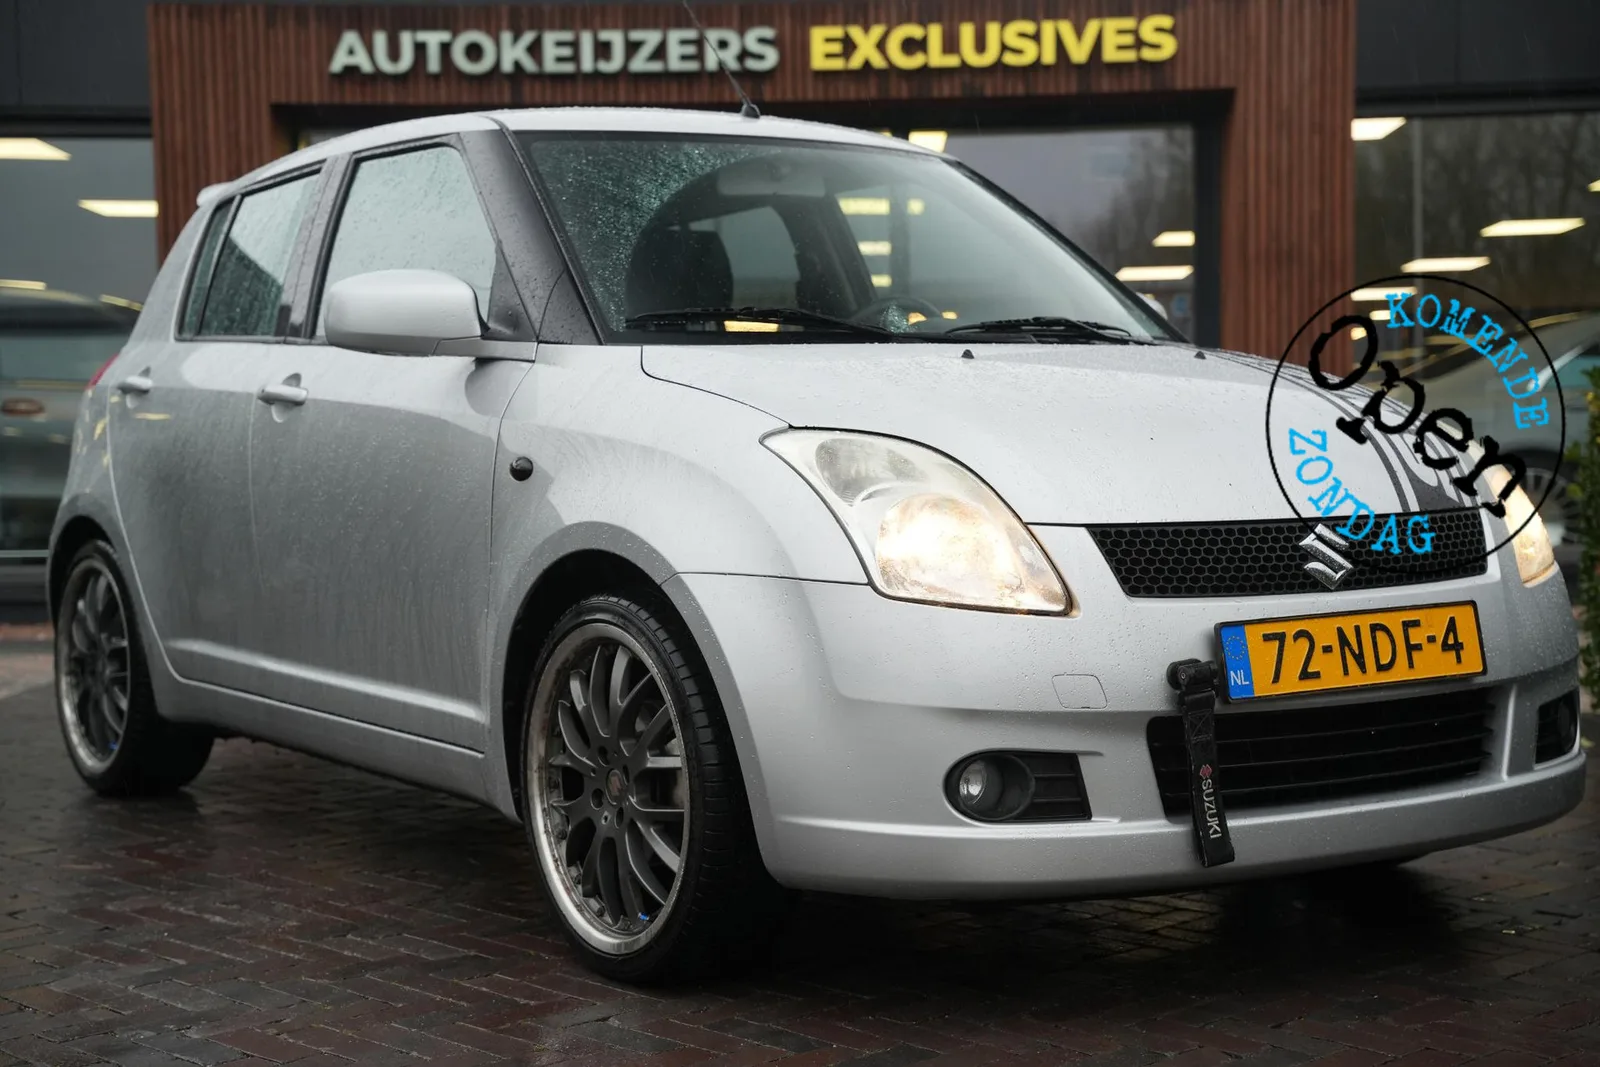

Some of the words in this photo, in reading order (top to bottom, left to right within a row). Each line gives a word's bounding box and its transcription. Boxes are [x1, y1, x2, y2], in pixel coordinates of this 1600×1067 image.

[329, 26, 780, 75] AUTOKEIJZERS
[809, 14, 1178, 71] EXCLUSIVES
[1230, 669, 1250, 687] NL
[1262, 616, 1464, 685] 72-NDF-4
[1200, 778, 1223, 840] SUZUKI
